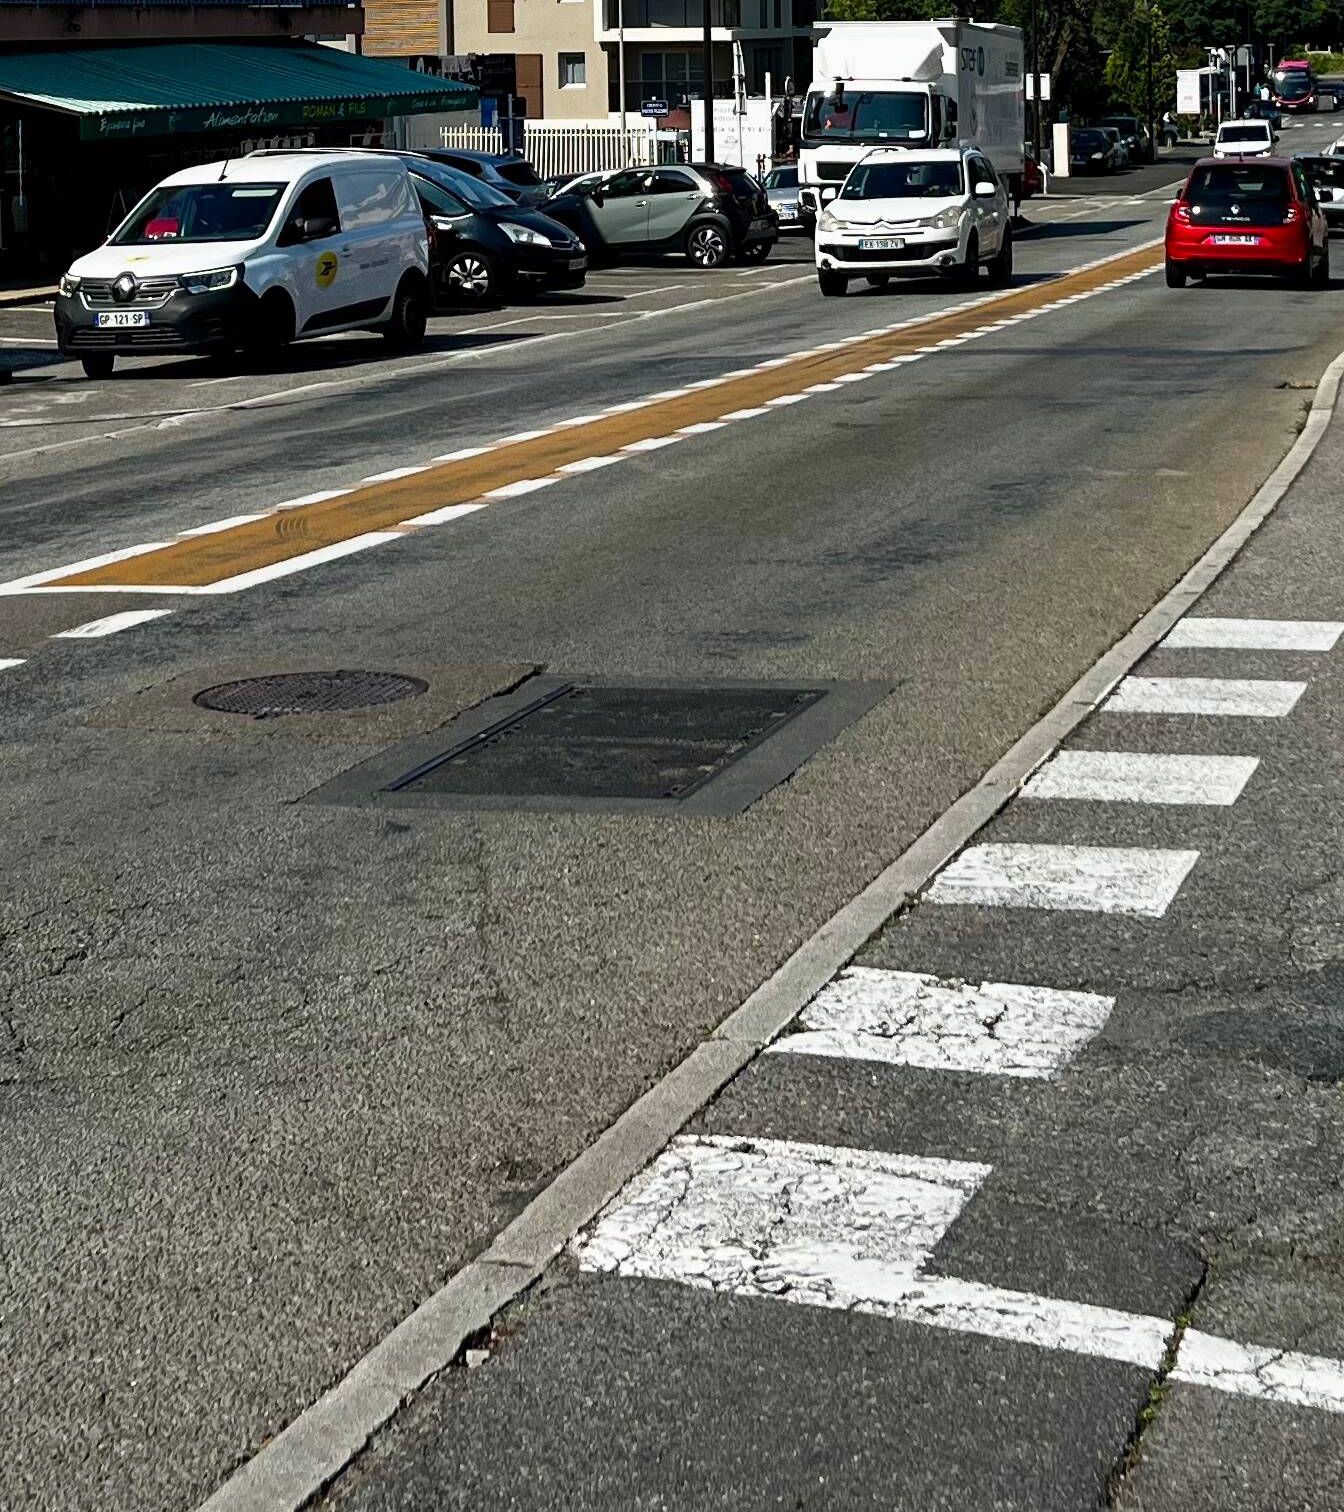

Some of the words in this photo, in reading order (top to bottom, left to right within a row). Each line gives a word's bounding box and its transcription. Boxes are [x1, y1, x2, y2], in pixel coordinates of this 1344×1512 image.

[203, 107, 279, 129] Alimentation
[99, 314, 110, 325] GP
[114, 314, 129, 325] 121
[132, 313, 144, 324] SP
